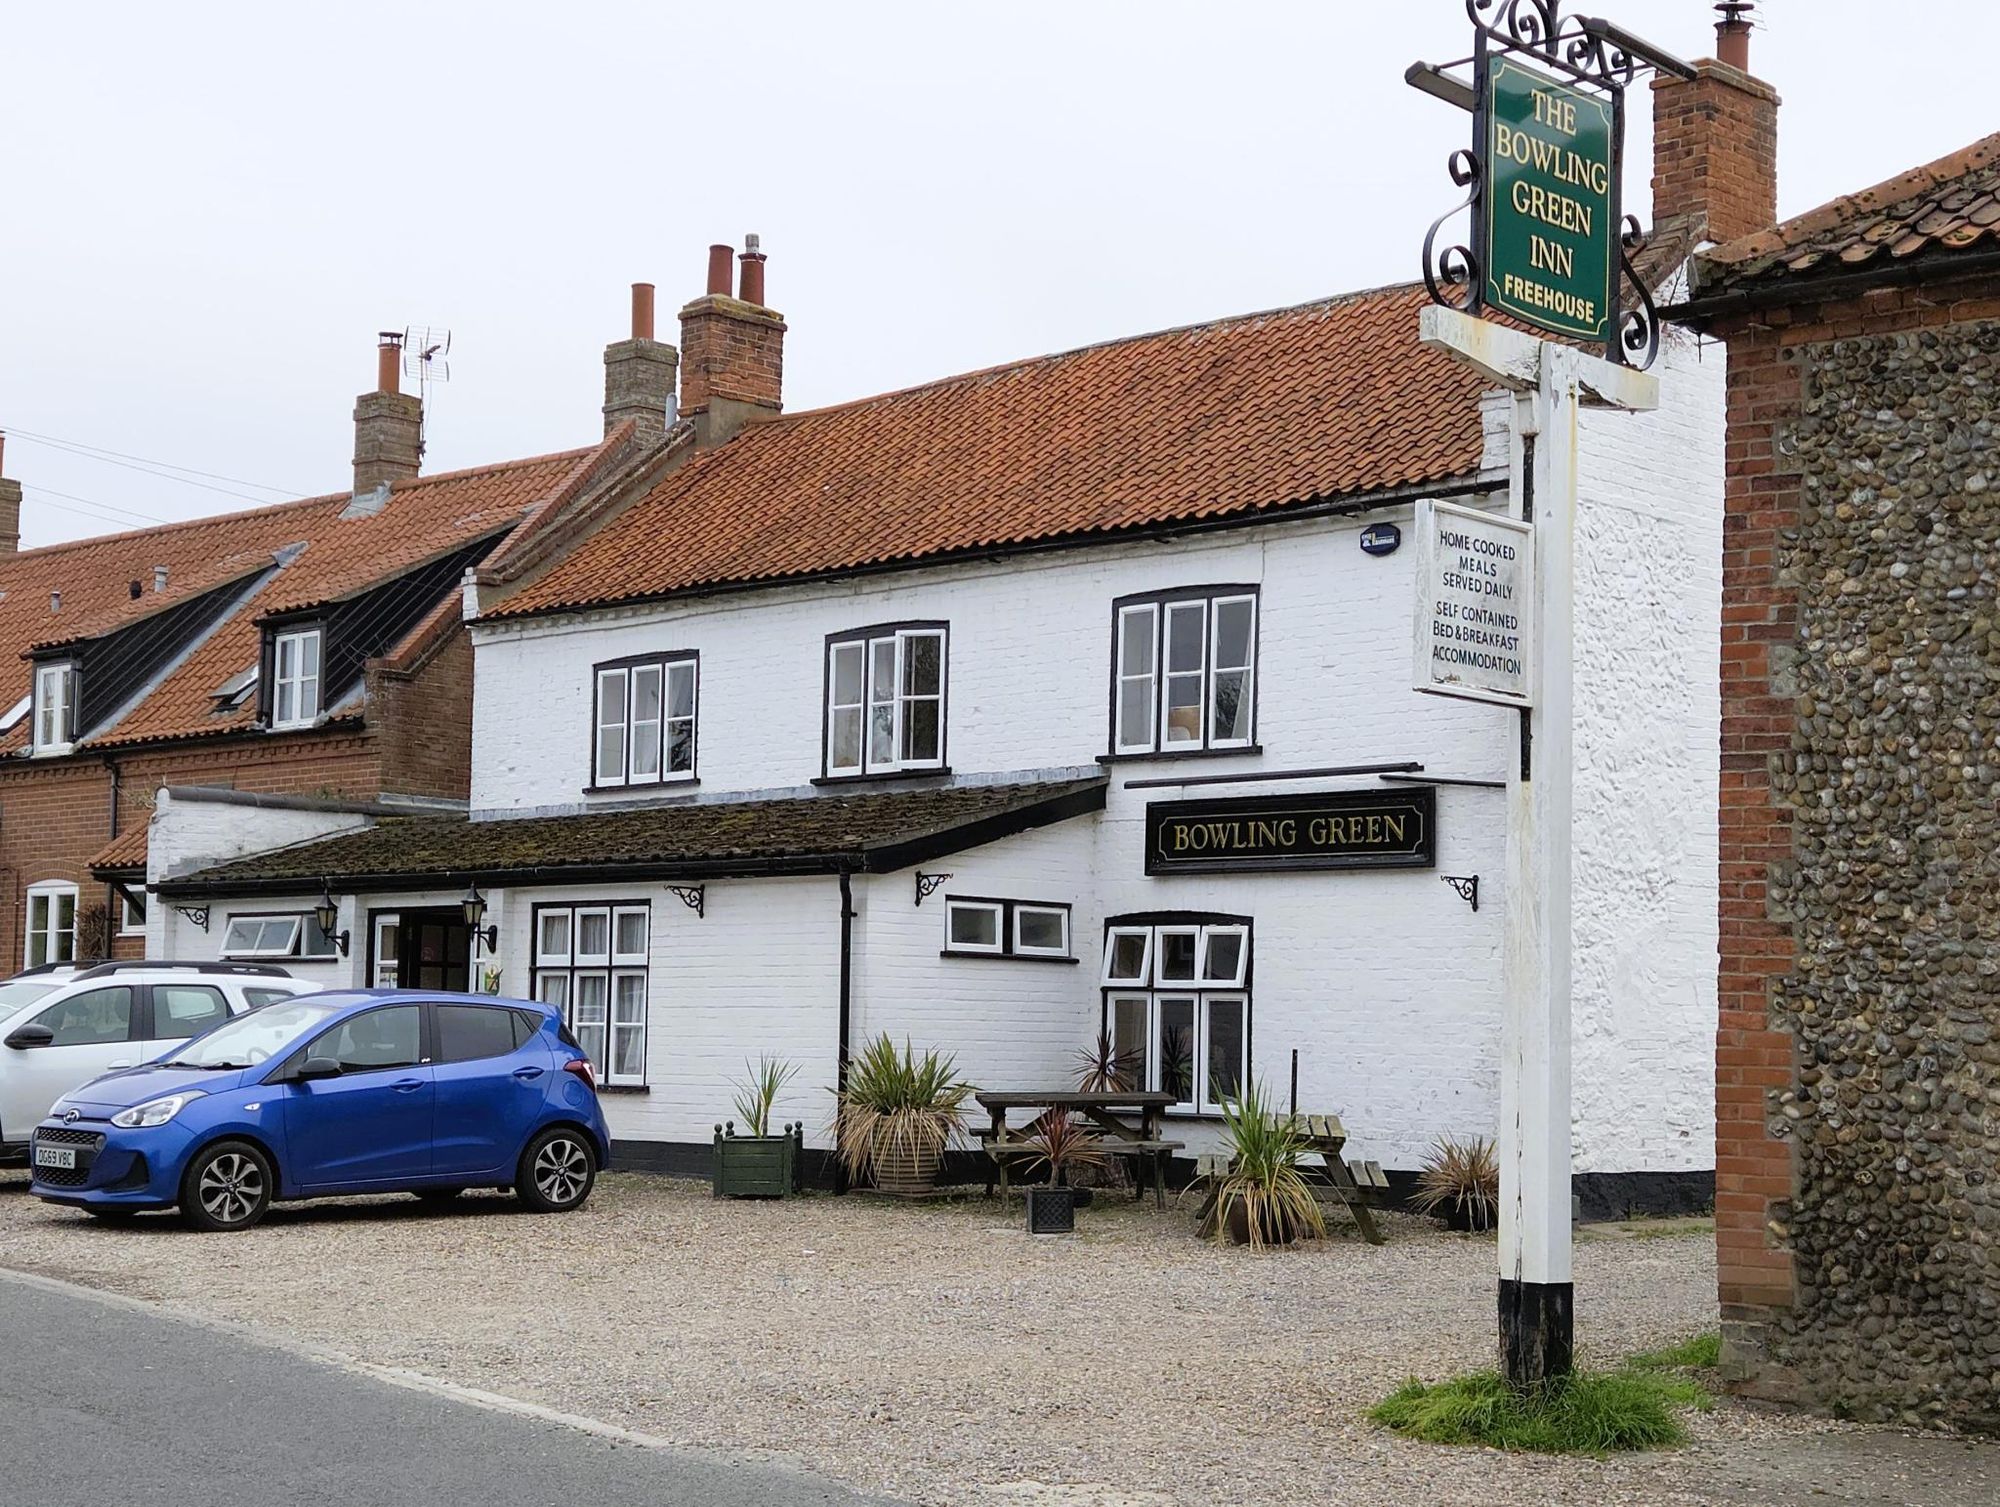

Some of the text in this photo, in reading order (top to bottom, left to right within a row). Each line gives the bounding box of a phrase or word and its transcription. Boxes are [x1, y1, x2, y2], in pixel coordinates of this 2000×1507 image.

[1531, 88, 1577, 137] THE
[1496, 123, 1608, 195] BOWLING
[1512, 180, 1592, 237] GREEN
[1530, 235, 1574, 279] INN
[1504, 273, 1594, 324] FREEHOUSE
[1440, 530, 1515, 561] HOME COOKED
[1459, 556, 1497, 577] MEALS
[1443, 572, 1513, 600] SERVED DAILY
[1433, 620, 1454, 639] BED
[1436, 601, 1518, 630] SELF CONTAINED
[1432, 645, 1521, 676] ACCOMMODATION
[1173, 815, 1406, 850] BOWLING GREEN
